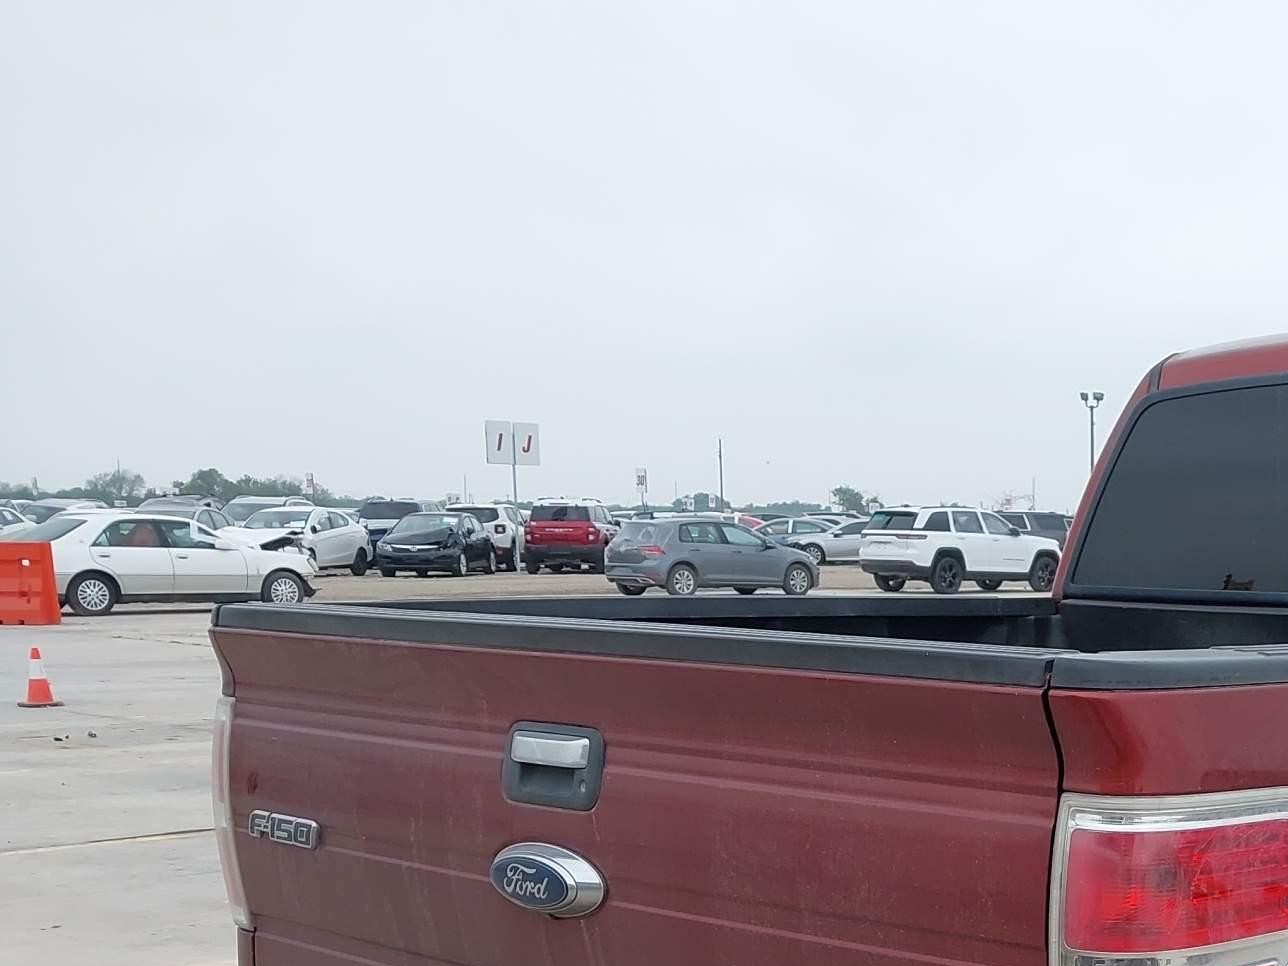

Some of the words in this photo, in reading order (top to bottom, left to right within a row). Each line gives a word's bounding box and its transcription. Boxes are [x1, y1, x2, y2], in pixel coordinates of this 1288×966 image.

[522, 434, 532, 453] J
[248, 810, 320, 850] F-150
[503, 863, 549, 899] Ford
